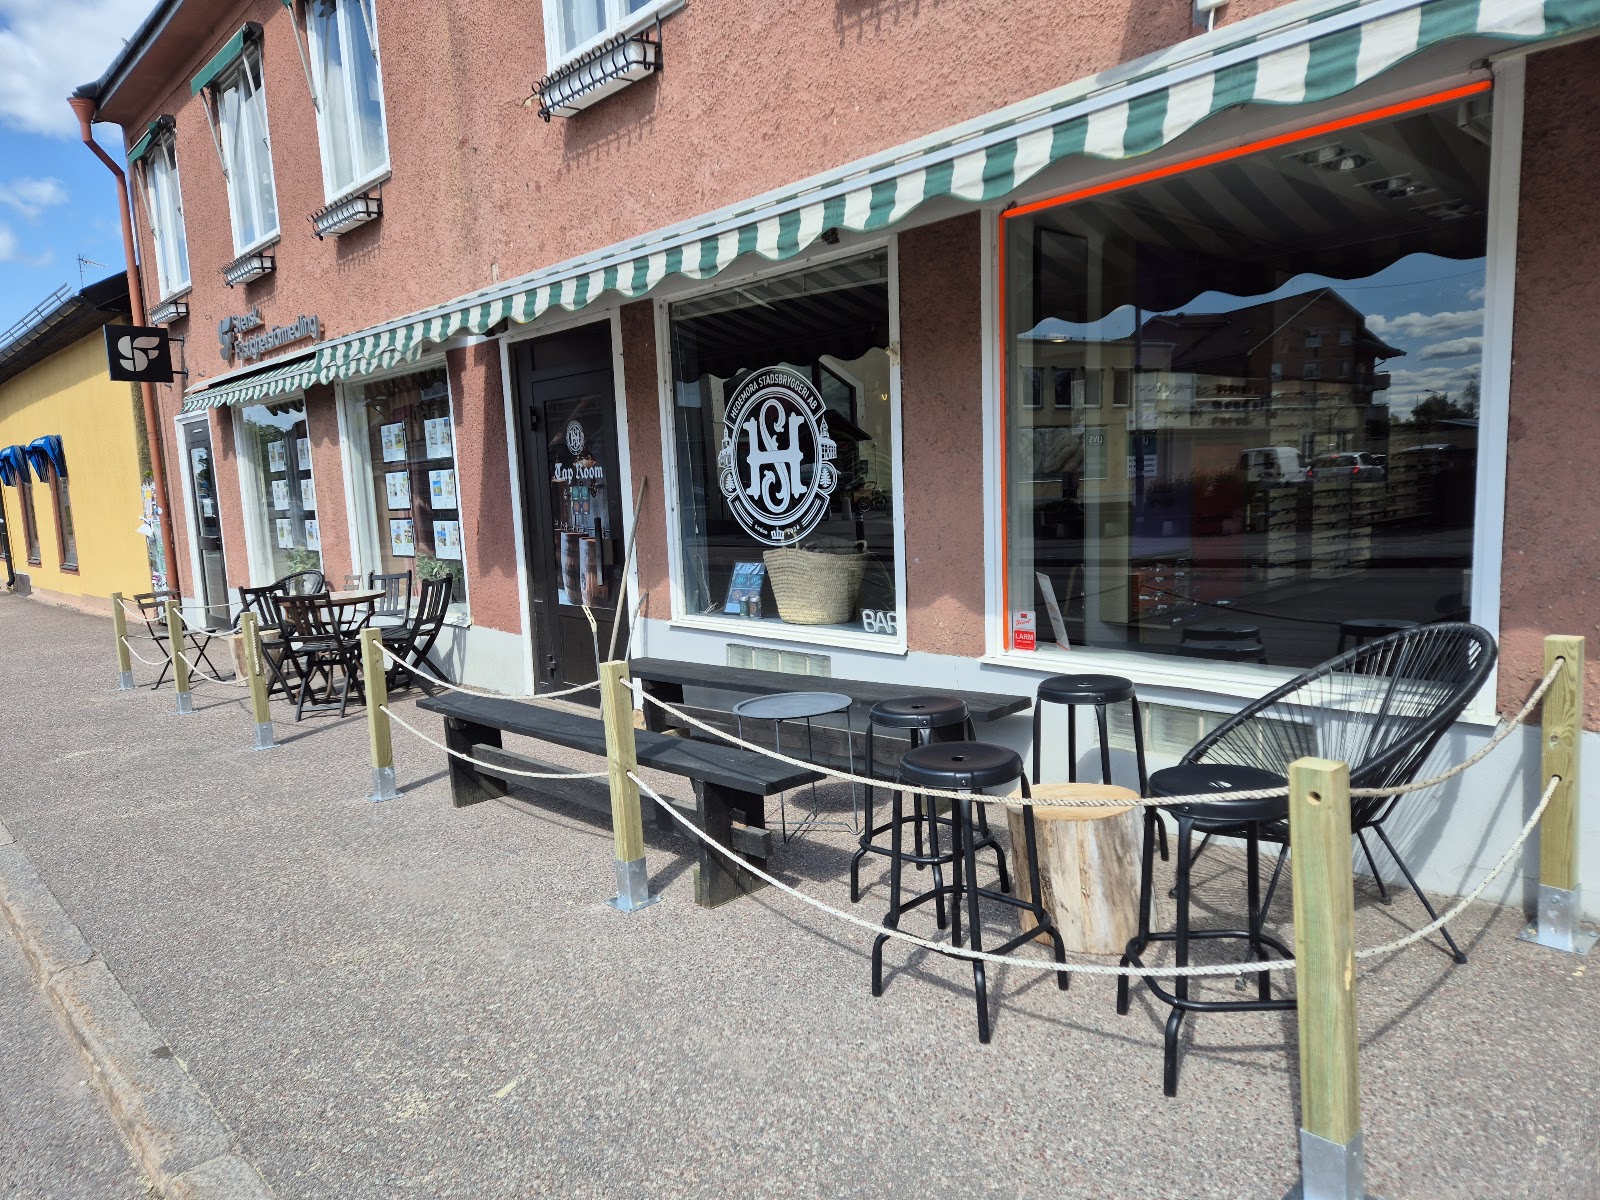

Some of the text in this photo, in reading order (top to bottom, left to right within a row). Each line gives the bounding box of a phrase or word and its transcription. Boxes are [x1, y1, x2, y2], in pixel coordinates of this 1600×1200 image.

[730, 373, 818, 419] HEDEMORA STADSBRYGGERI AB
[555, 462, 604, 485] Tap Room
[862, 610, 897, 635] BAR
[1015, 632, 1034, 641] LARM
